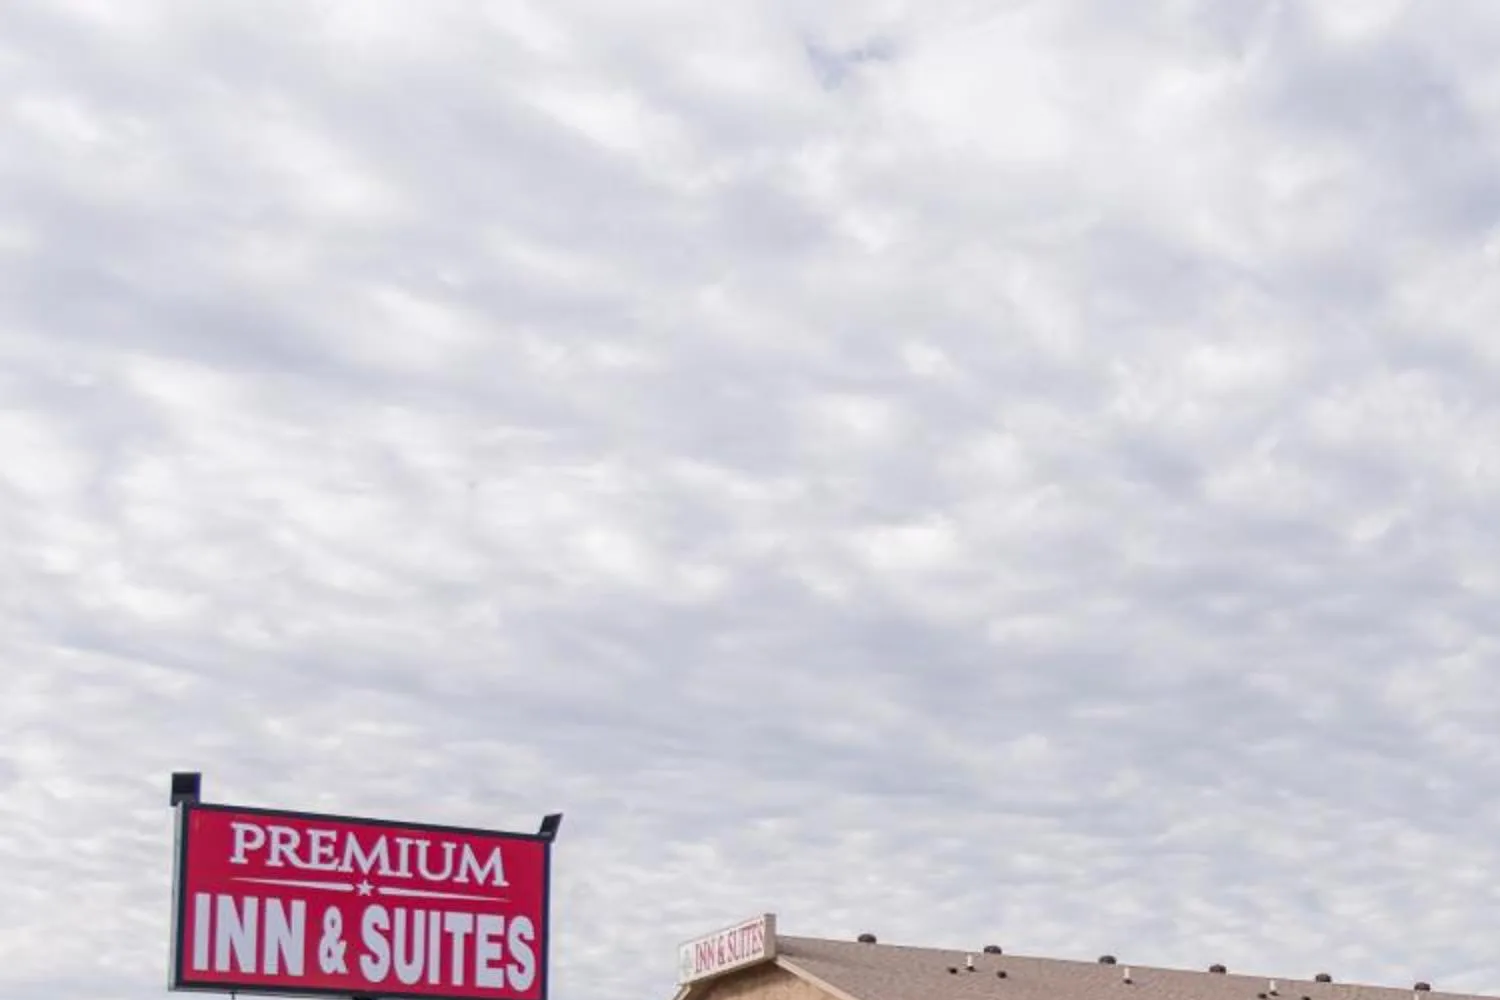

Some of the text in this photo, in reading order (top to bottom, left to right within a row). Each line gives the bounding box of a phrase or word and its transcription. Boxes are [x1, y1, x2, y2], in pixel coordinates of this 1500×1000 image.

[229, 821, 510, 888] PREMIUM
[193, 892, 536, 993] INN & SUITES
